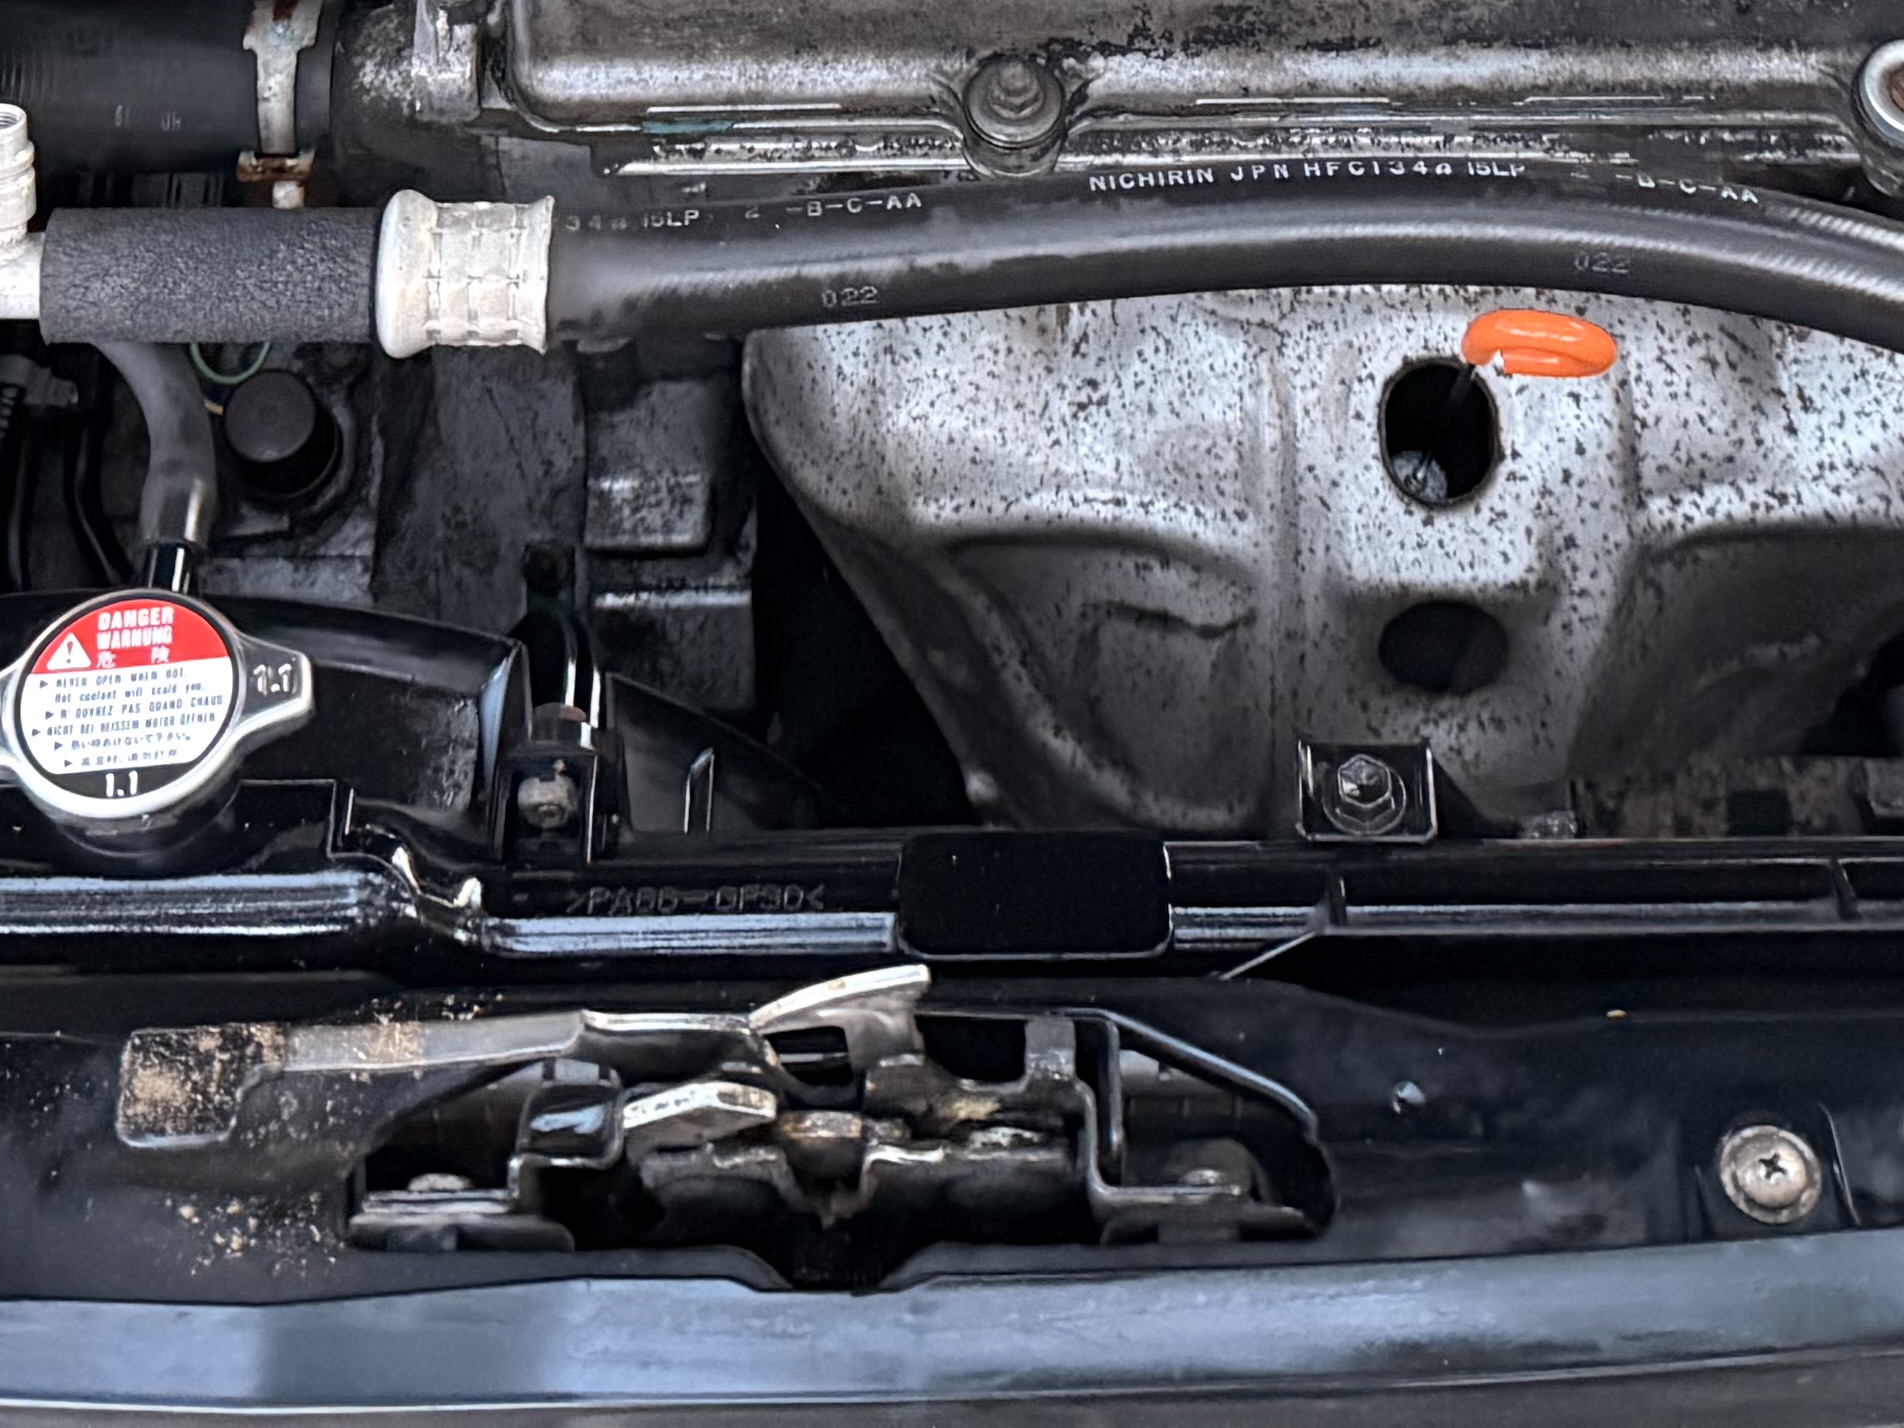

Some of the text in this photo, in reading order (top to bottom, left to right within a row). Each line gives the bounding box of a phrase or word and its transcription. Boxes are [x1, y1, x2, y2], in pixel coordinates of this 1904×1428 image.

[1087, 165, 1215, 193] NICHIRIN
[1229, 161, 1291, 182] JPN
[1301, 156, 1454, 179] HFC134a
[96, 605, 175, 631] DANGER
[95, 626, 173, 651] WARNUNG
[253, 663, 293, 696] 1.1
[120, 702, 141, 714] PAS
[103, 769, 140, 797] 1.1
